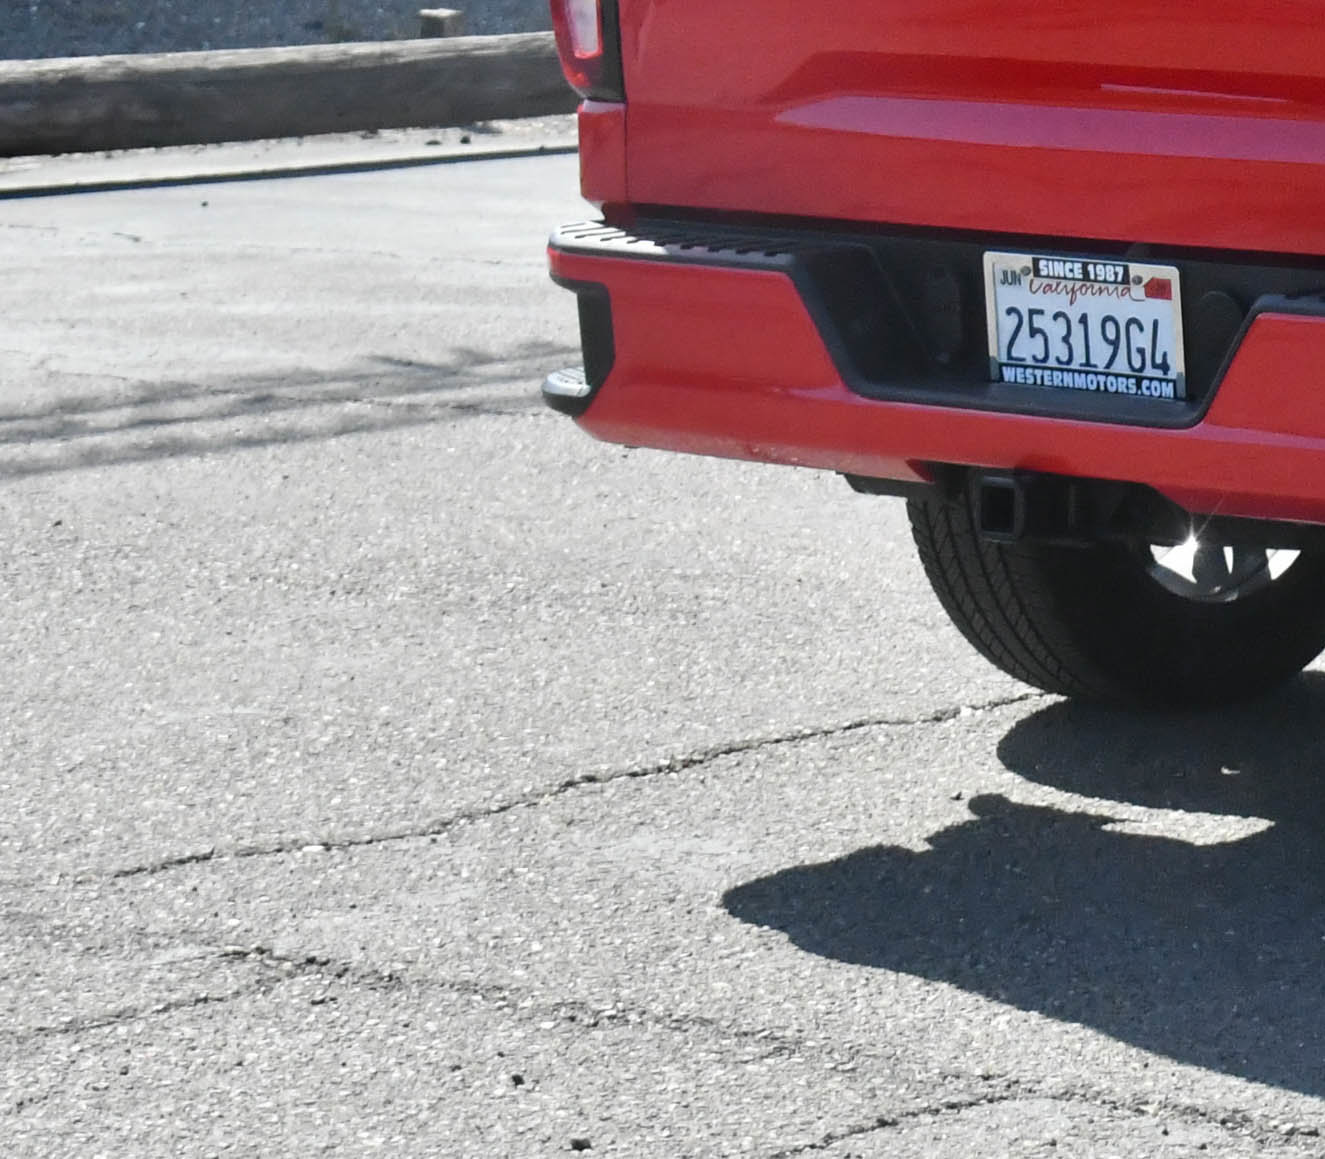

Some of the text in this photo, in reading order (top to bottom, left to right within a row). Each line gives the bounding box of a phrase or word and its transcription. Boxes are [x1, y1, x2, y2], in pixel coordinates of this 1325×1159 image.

[1038, 259, 1124, 282] SINCE 1987
[1005, 306, 1170, 376] 25319G4
[1002, 366, 1175, 399] WESTERNMOTORS.COM
